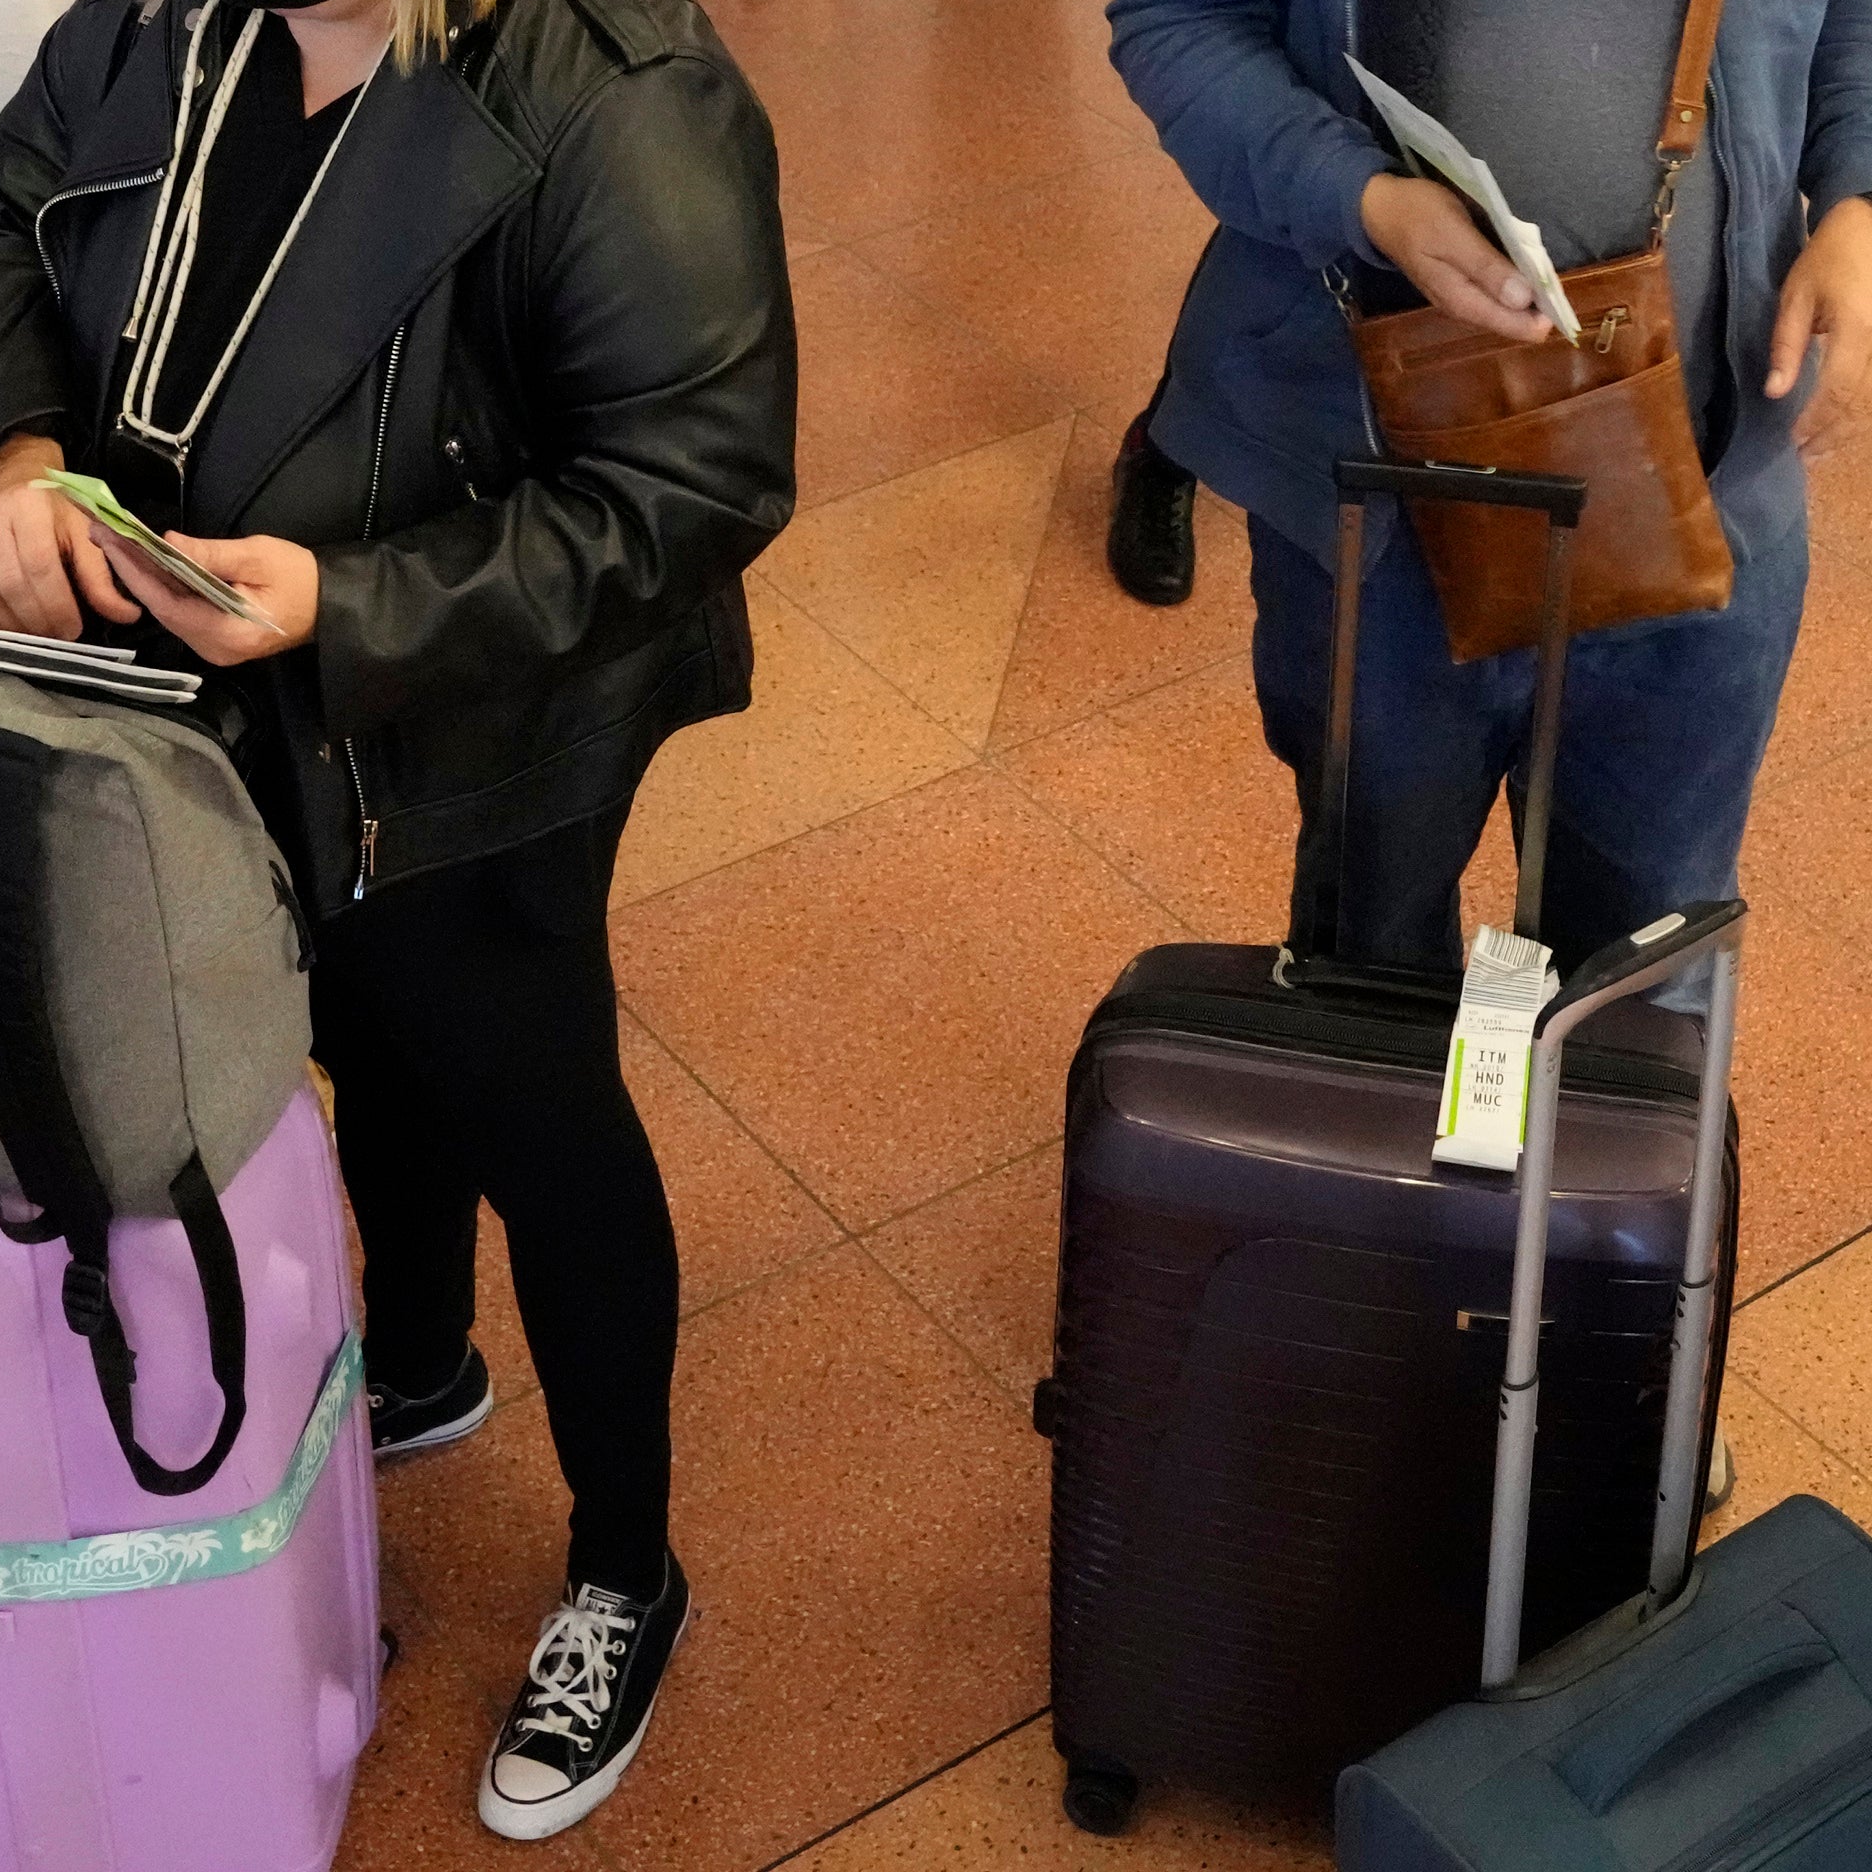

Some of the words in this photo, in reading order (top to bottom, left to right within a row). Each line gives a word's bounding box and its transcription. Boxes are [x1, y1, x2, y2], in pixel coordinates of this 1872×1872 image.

[1478, 1050, 1507, 1064] ITM
[1475, 1071, 1504, 1086] HND
[1473, 1092, 1502, 1107] MUC
[10, 1544, 140, 1588] tropical
